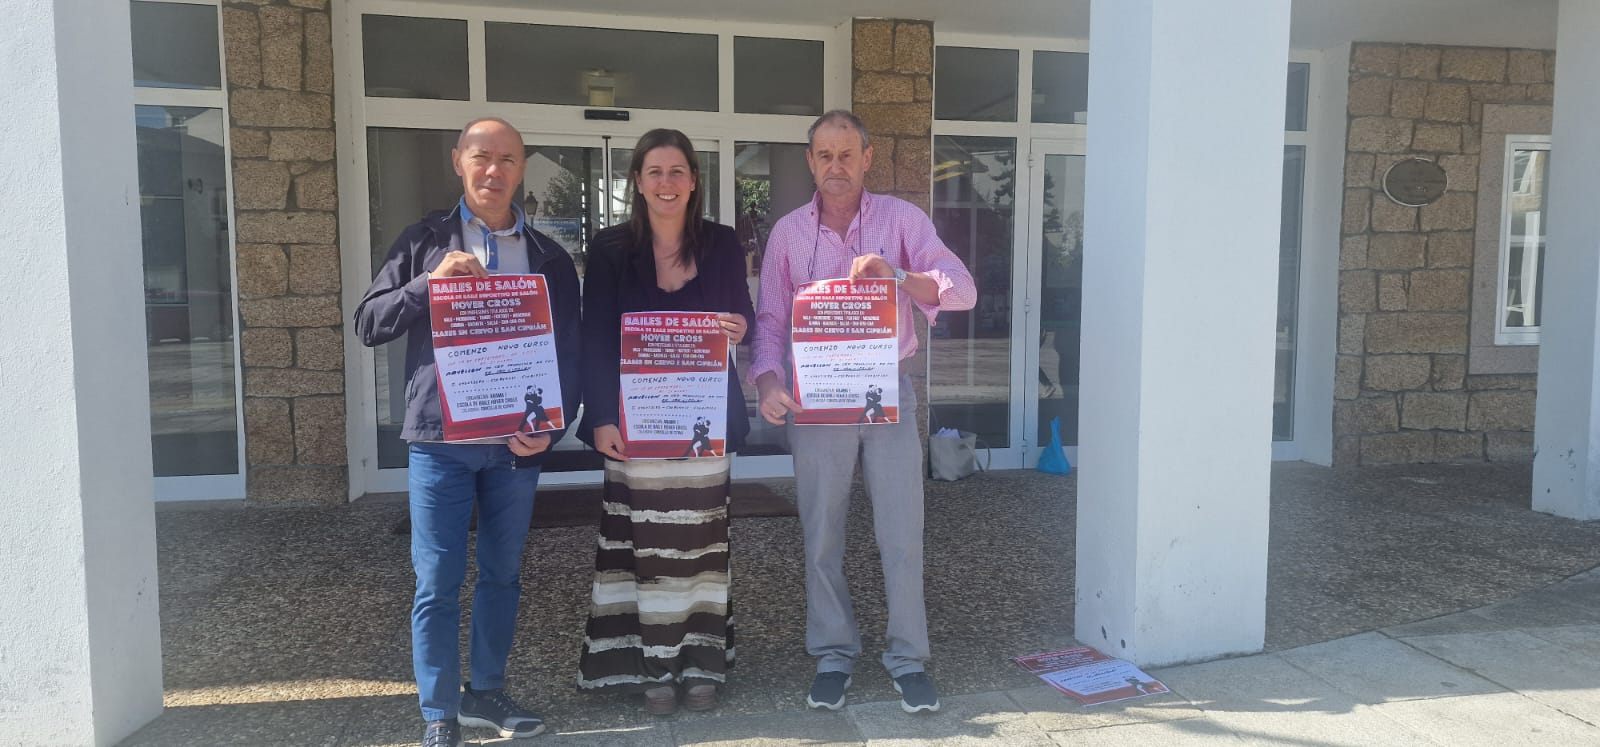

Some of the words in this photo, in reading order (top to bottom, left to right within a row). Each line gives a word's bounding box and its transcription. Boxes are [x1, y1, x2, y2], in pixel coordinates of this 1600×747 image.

[432, 282, 472, 294] BAILES
[476, 281, 492, 292] DE
[495, 277, 537, 290] SALÓN
[834, 285, 847, 294] DE
[851, 281, 887, 294] SALÓN
[452, 300, 484, 310] HOVER
[486, 298, 521, 308] CROSS
[624, 316, 662, 326] BAILES
[666, 318, 680, 326] DE
[641, 334, 671, 342] HOVER
[673, 334, 703, 342] CROSS
[448, 347, 487, 358] COMENZO
[523, 340, 549, 348] CURSO
